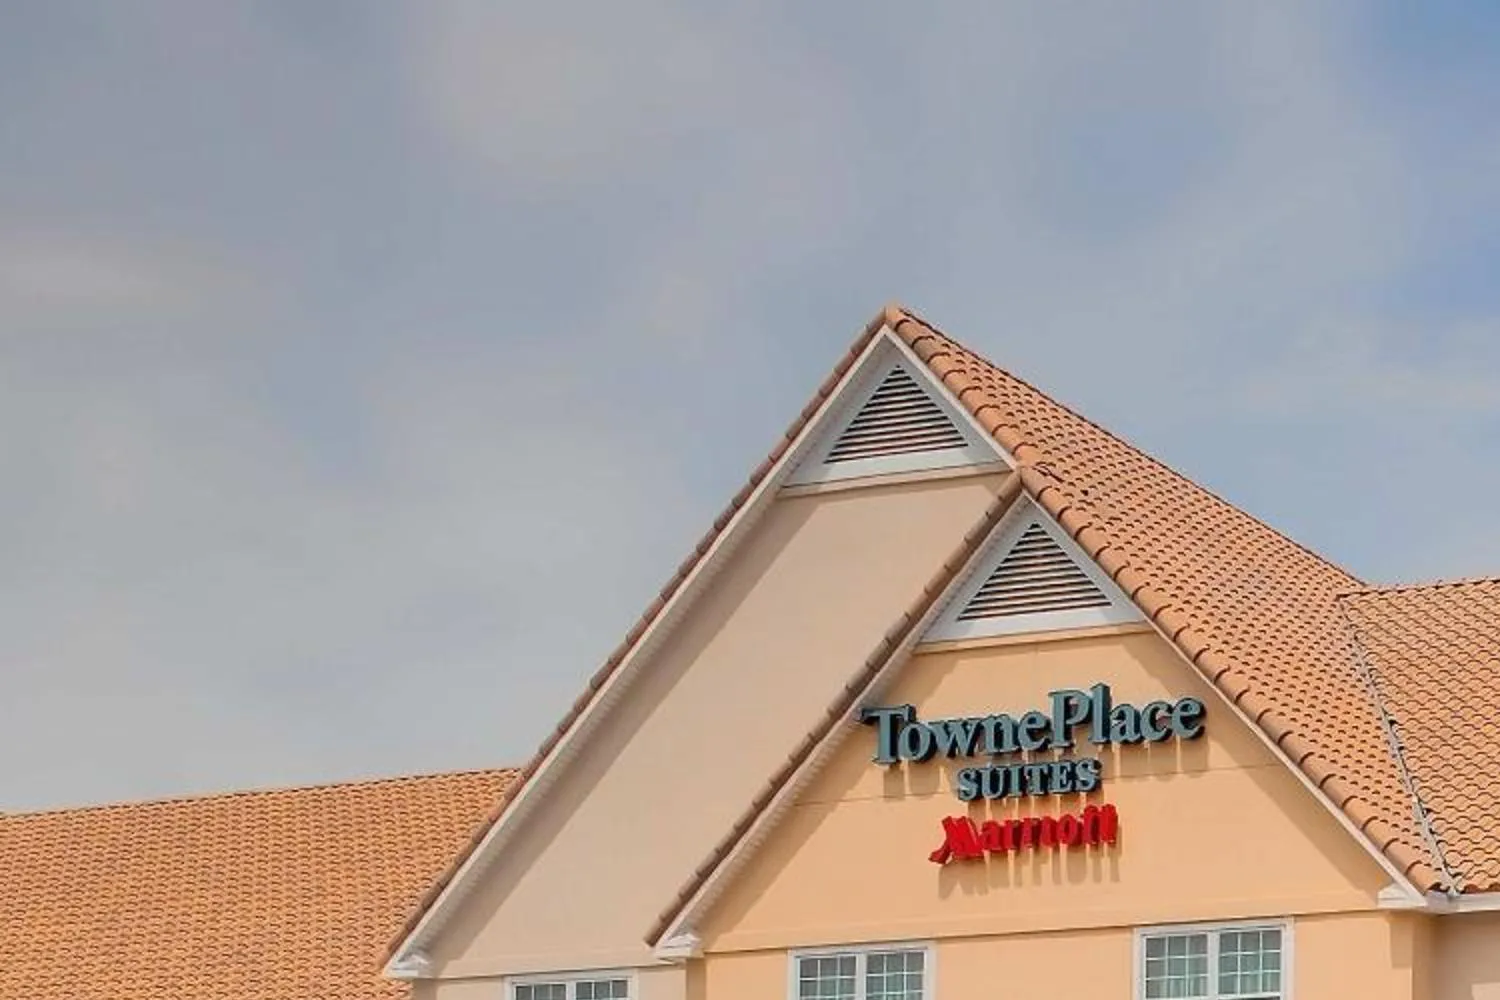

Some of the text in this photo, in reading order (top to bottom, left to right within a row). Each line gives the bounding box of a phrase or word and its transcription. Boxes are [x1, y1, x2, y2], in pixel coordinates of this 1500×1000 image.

[861, 682, 1207, 765] TownePlace
[956, 757, 1101, 802] SUITES
[928, 804, 1119, 865] Marriott
